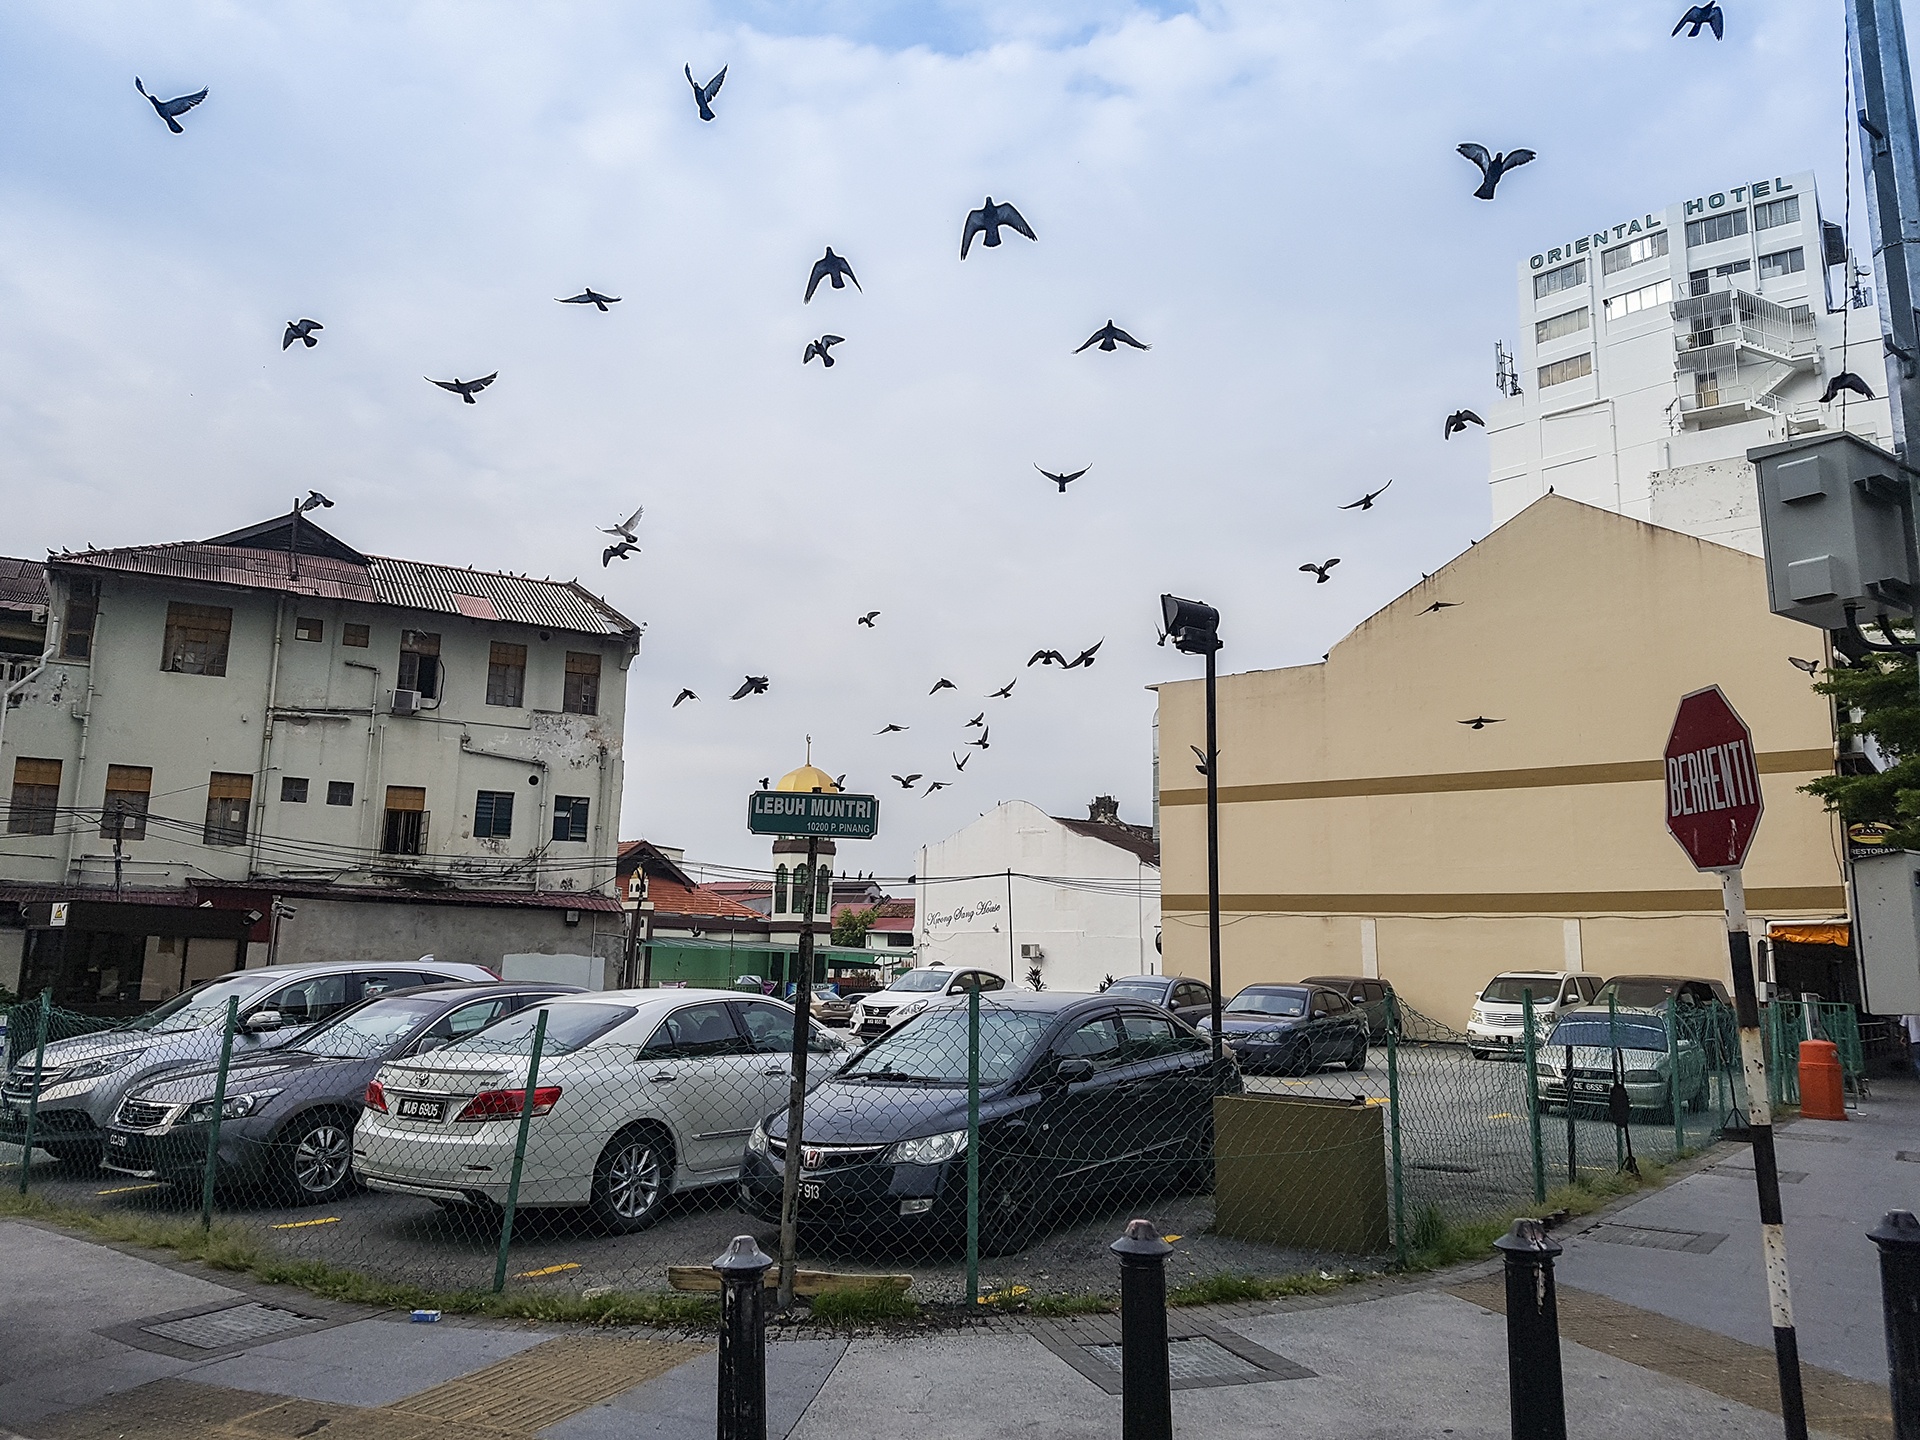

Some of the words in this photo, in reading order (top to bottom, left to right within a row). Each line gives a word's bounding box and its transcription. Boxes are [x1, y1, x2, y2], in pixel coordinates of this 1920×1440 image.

[1530, 214, 1661, 270] ORIENTAL
[1687, 177, 1793, 215] HOTEL
[1668, 739, 1755, 817] BERHENTI
[755, 796, 806, 815] LEBUH
[810, 798, 871, 818] MUNTRI
[807, 821, 829, 832] 10200
[830, 823, 837, 832] P.
[838, 823, 870, 833] PINANG
[954, 906, 975, 923] Sang
[976, 900, 1001, 916] House
[402, 1102, 418, 1115] WUB
[418, 1103, 439, 1117] 6905
[804, 1183, 820, 1199] 913
